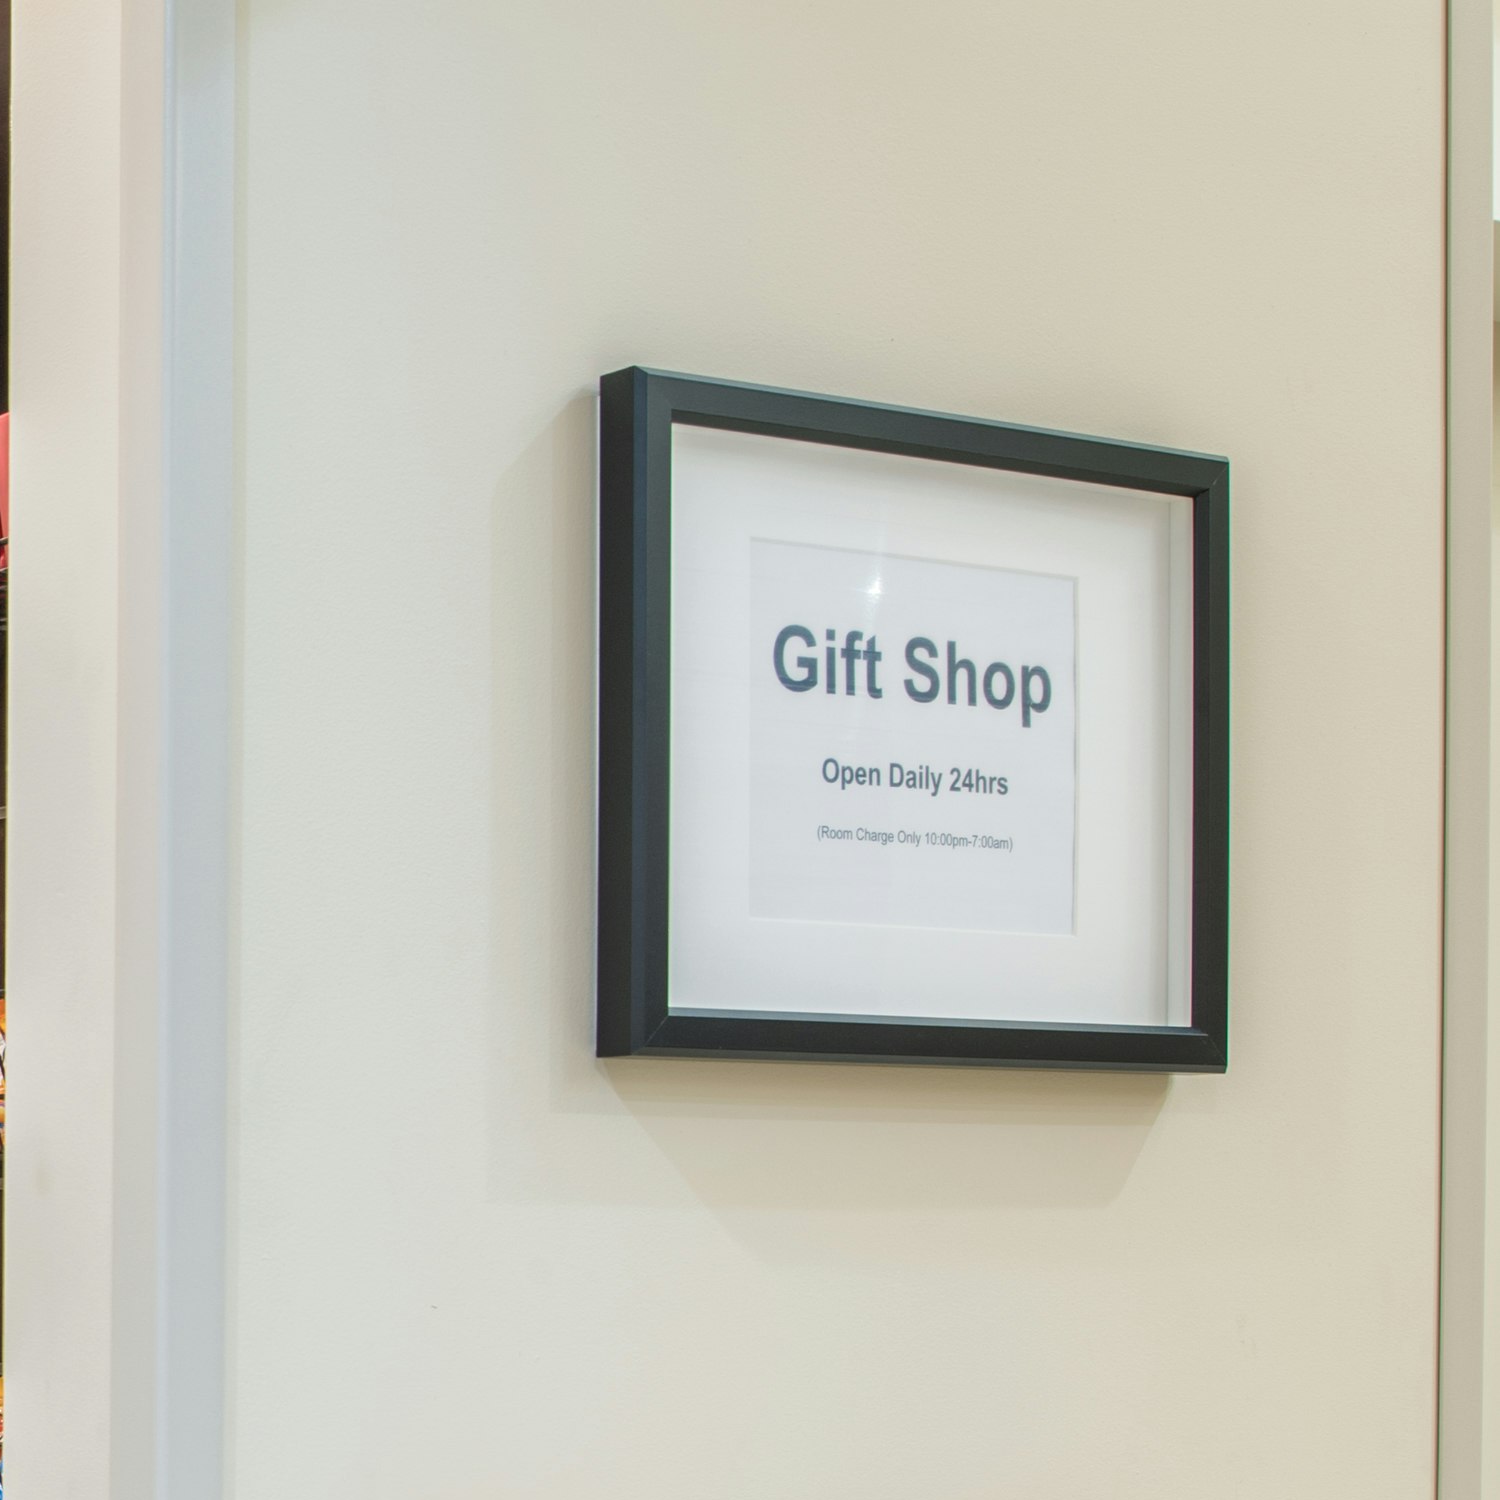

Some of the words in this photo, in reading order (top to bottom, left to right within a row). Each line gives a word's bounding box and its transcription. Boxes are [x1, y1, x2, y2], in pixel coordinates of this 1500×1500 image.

[773, 624, 883, 699] Gift
[904, 636, 1051, 728] Shop
[822, 758, 881, 790] Open
[889, 762, 942, 796] Daily
[949, 767, 1008, 795] 24hrs
[817, 825, 853, 841] (Room
[856, 827, 894, 845] Charge
[897, 831, 921, 847] Only
[925, 832, 1013, 852] 10:00pm-7:00am)
